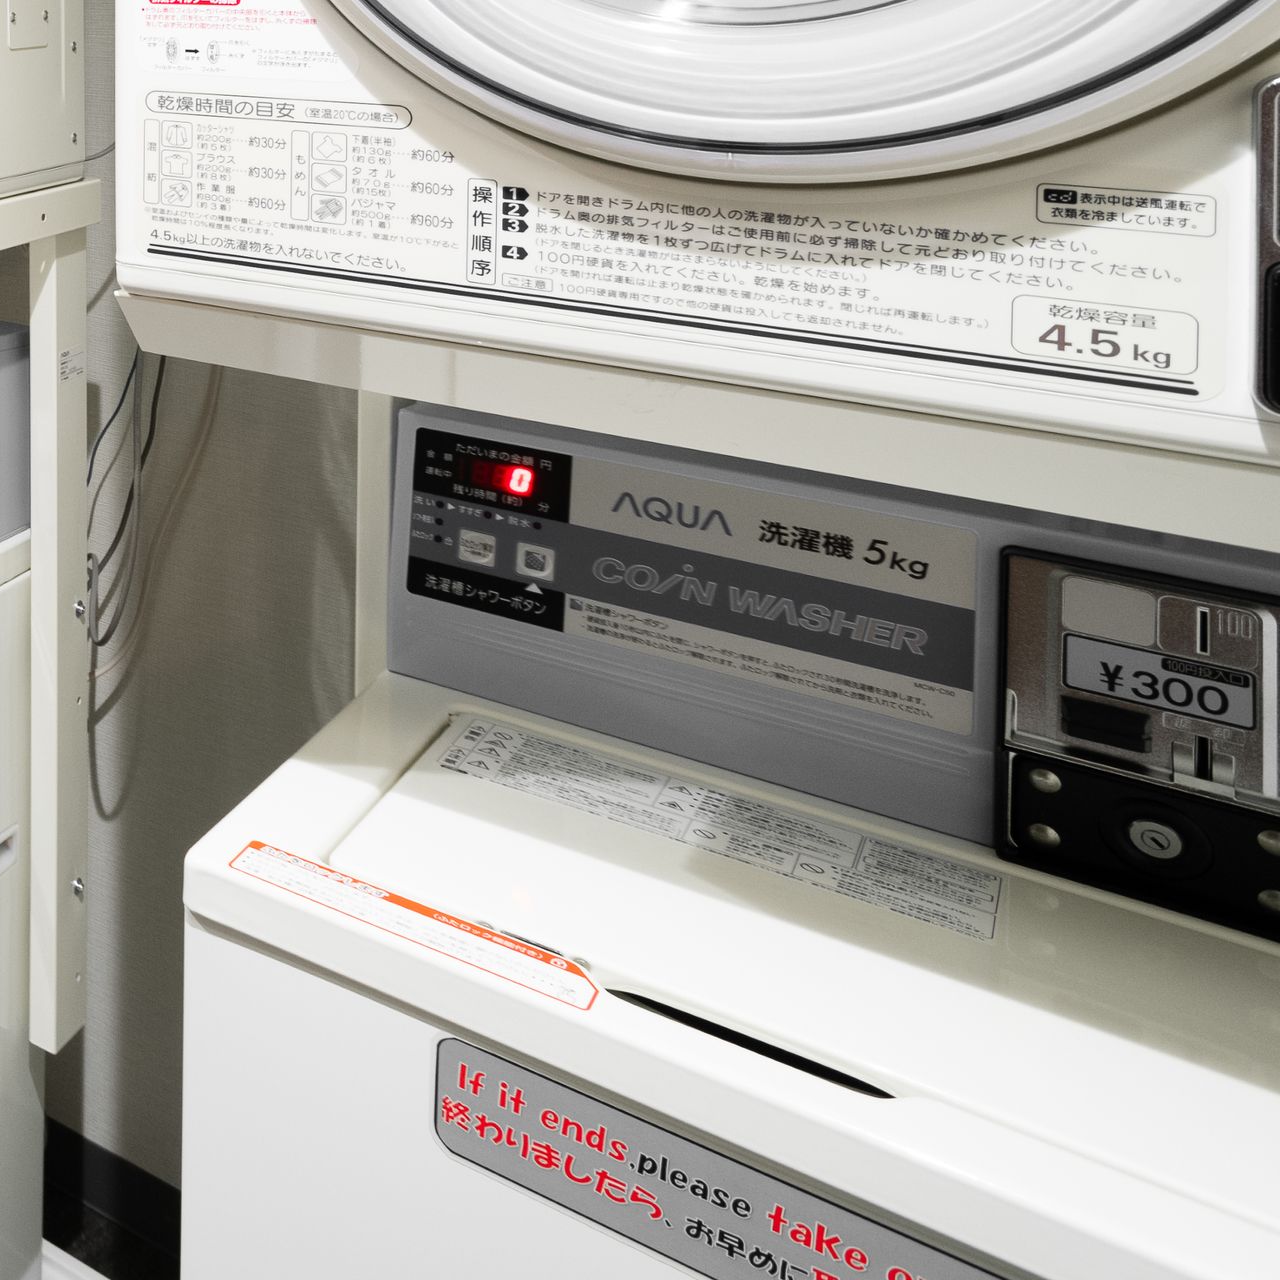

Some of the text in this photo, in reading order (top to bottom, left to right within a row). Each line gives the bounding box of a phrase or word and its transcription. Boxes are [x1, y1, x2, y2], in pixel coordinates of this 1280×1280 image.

[157, 95, 296, 119] 乾燥時間の目安
[248, 136, 287, 150] 約30分
[411, 149, 455, 164] 約60分
[248, 166, 287, 180] 約30分
[410, 182, 454, 196] 約60分
[248, 197, 286, 211] 約60分
[507, 204, 520, 216] 2
[1080, 192, 1206, 214] 表示中は送風運転で
[410, 214, 454, 229] 約60分
[507, 220, 520, 232] 3
[508, 188, 1098, 256] 1 ドアを開きドラム内に他の人の洗濯物が入っていないか確かめてください。
[1051, 207, 1198, 230] 衣類を冷ましています。
[471, 186, 493, 277] 操作順序
[150, 229, 407, 272] 4.5kg以上の洗濯物を入れないでください。
[505, 247, 880, 302] 4 100円硬貨を入れてください。乾燥を始めます。
[507, 276, 547, 291] ご注意
[1049, 305, 1157, 330] 乾燥容量
[1038, 323, 1171, 369] 4.5 kg
[456, 443, 552, 471] ただいまの金額 円
[509, 467, 533, 493] 0
[611, 492, 929, 580] AQUA 洗濯機 5kg
[425, 573, 547, 615] 洗濯槽シャワーボタン
[592, 564, 929, 656] COIN WASHER
[1166, 659, 1245, 685] 100円投入口
[1100, 660, 1229, 715] ¥300
[457, 1063, 487, 1096] If
[498, 1082, 527, 1115] it
[767, 1204, 869, 1272] take
